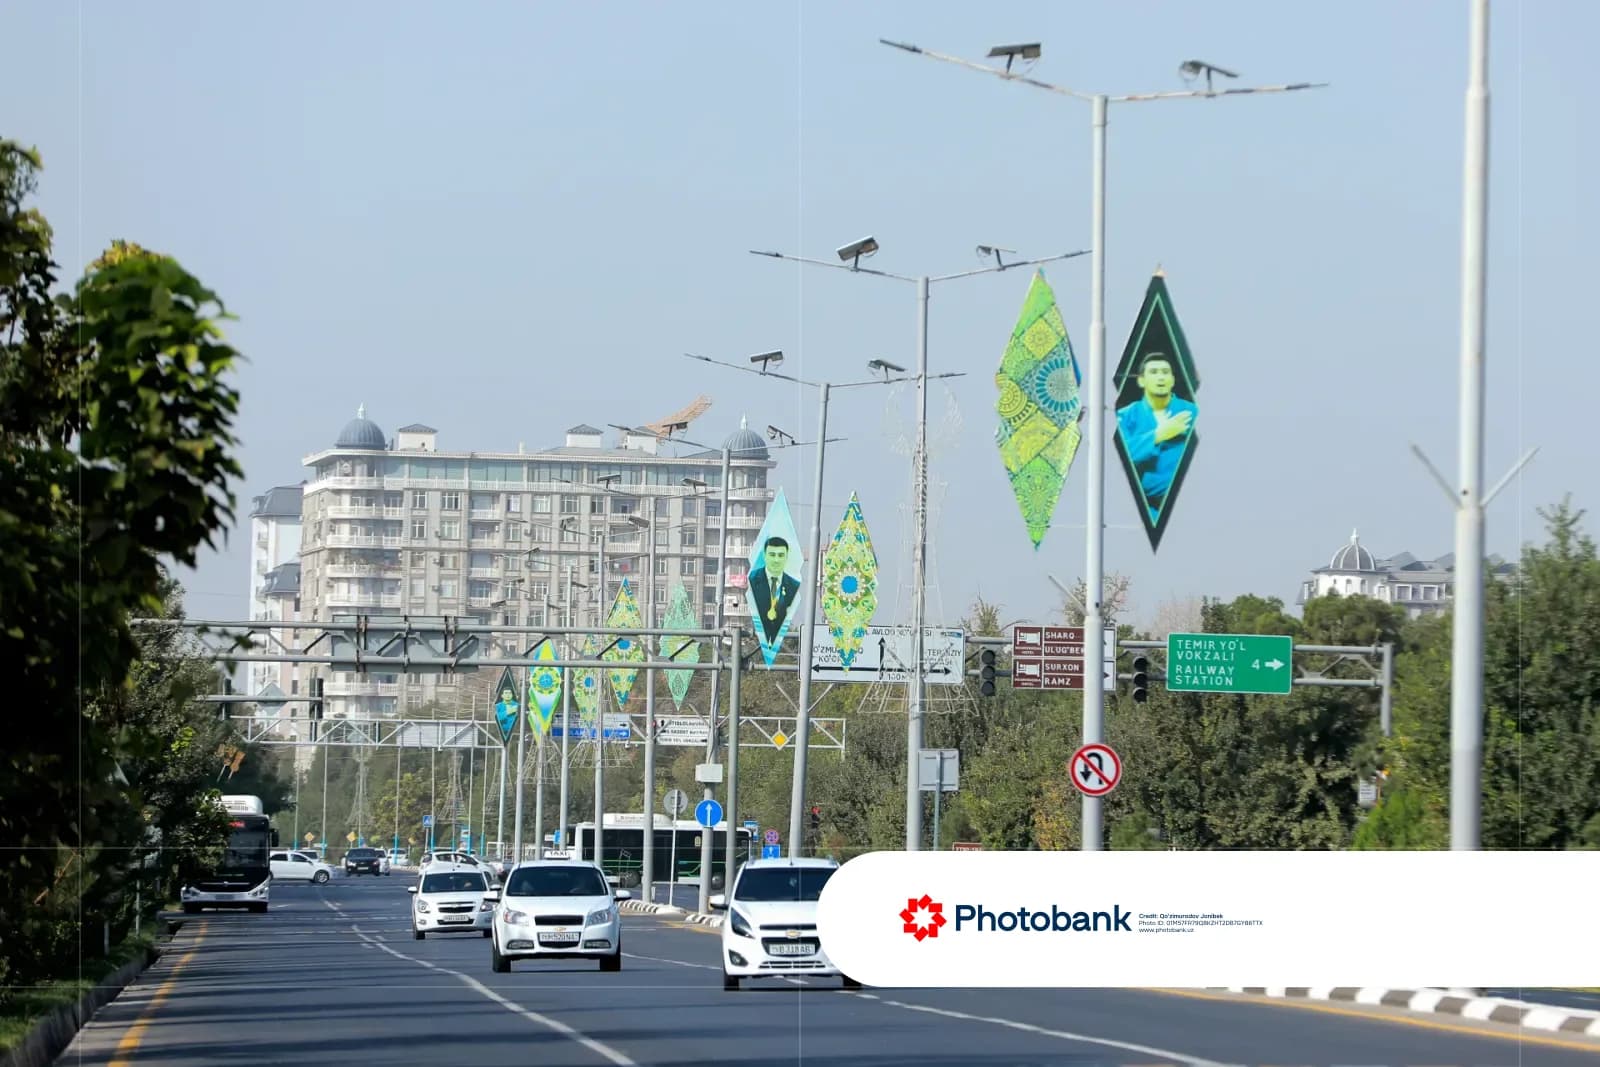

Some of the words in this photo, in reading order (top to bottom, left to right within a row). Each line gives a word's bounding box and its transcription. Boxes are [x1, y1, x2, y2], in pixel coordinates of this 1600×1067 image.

[1177, 640, 1216, 650] TEMIR
[1219, 639, 1247, 651] YO'L
[1177, 650, 1234, 661] VOKZALI
[1045, 663, 1080, 672] SURXON
[1251, 659, 1260, 670] 4
[1176, 665, 1235, 676] RAILWAY
[1045, 678, 1071, 686] RAMZ
[1176, 675, 1233, 686] STATION
